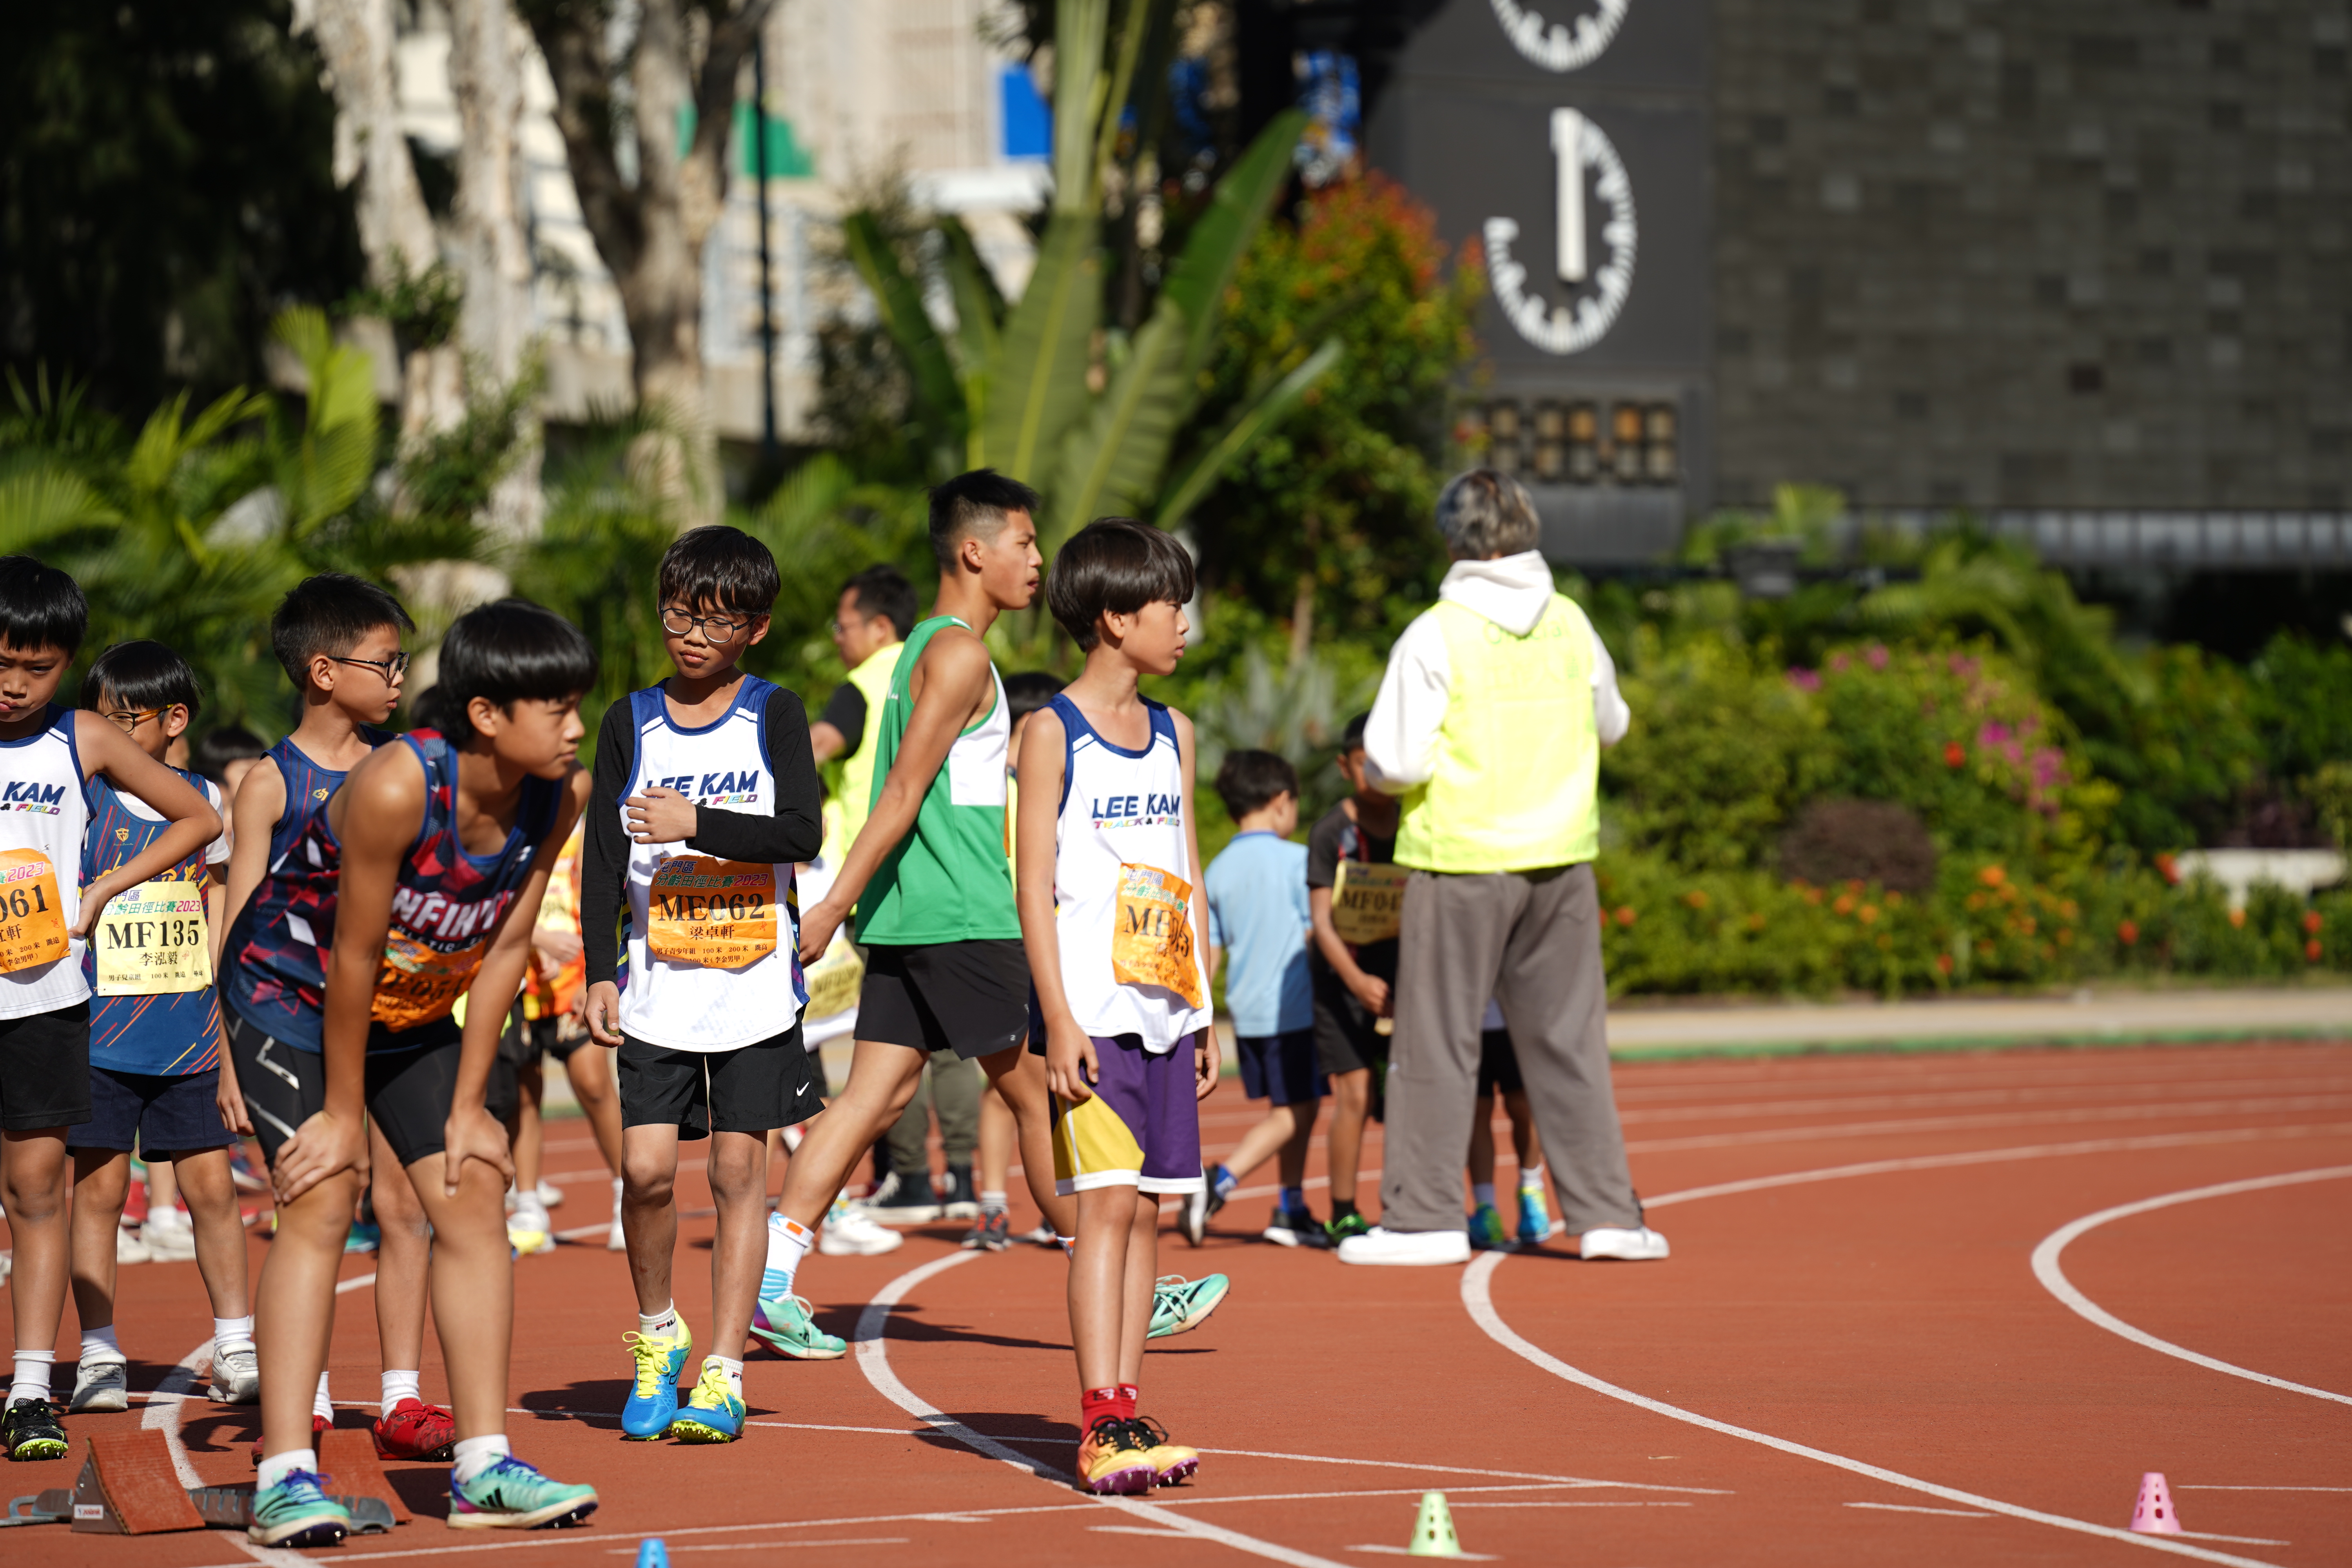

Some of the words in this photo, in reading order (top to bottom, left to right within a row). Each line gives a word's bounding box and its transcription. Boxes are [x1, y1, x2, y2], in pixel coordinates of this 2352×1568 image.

[699, 770, 759, 796] KAM
[2, 782, 65, 805] KAM
[712, 794, 758, 805] FIELD
[16, 804, 60, 815] FIELD
[1092, 796, 1138, 818] LEE
[1147, 794, 1180, 816] KAM
[1094, 817, 1144, 829] TRACK
[660, 860, 697, 873] 屯門區
[1126, 869, 1165, 886] 屯門區
[658, 893, 764, 921] ME062
[106, 920, 199, 949] MF135
[689, 925, 735, 940] 梁卓軒
[20, 944, 32, 953] 200
[46, 936, 60, 946] 跳遠
[139, 951, 178, 966] 李泓毅
[109, 973, 142, 981] 男子兒童組
